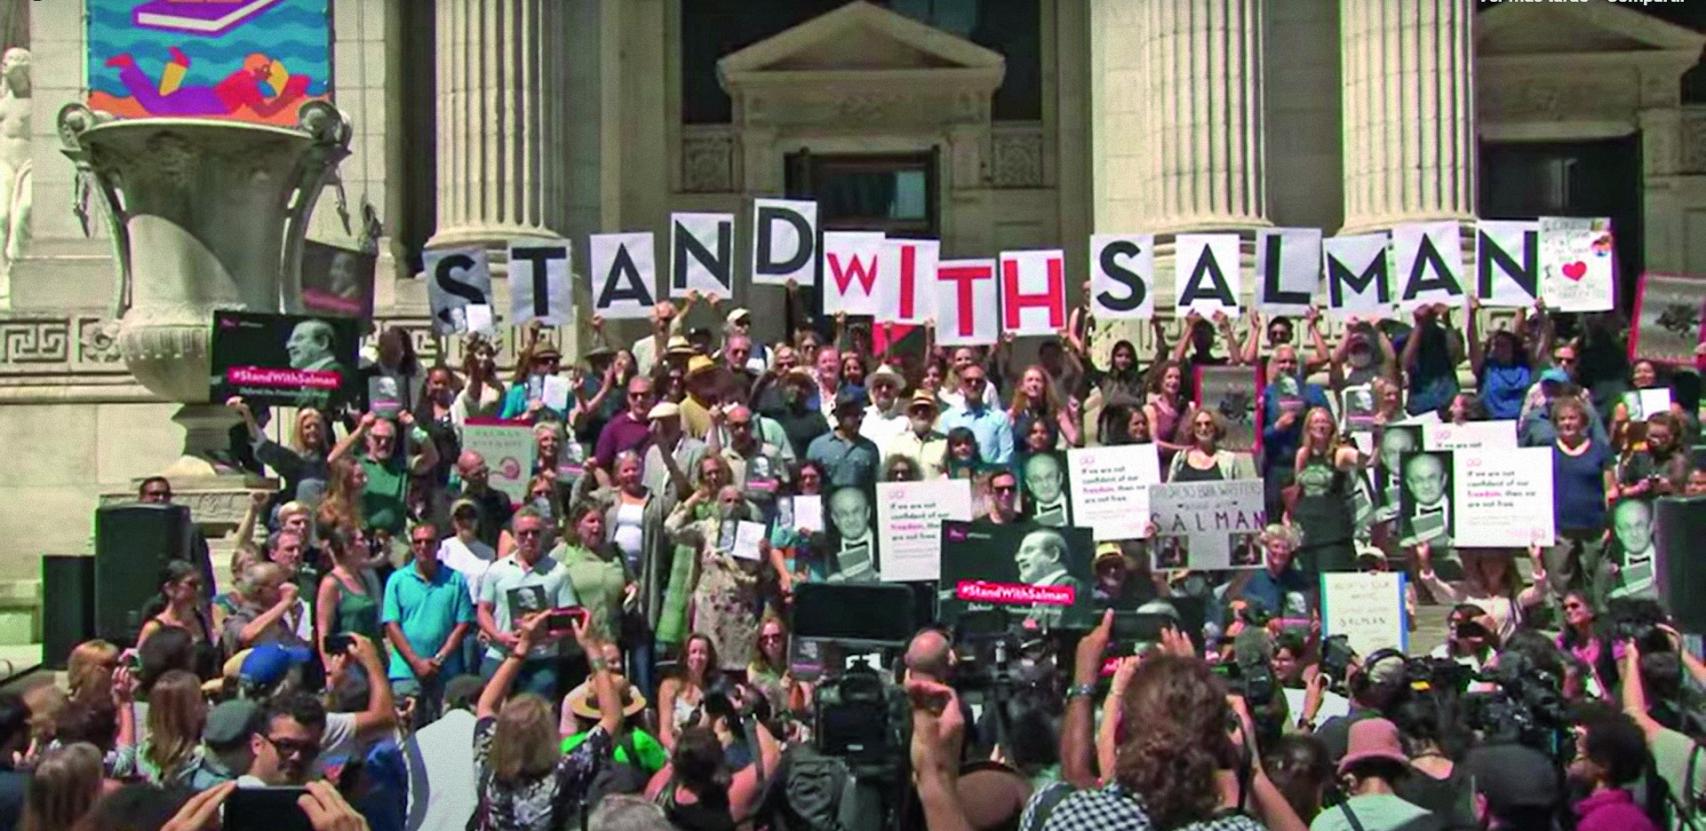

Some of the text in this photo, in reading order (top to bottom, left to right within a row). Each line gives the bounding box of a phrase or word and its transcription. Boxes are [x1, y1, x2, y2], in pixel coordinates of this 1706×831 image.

[826, 245, 1065, 337] WITH
[1096, 230, 1539, 312] SALMAN
[233, 369, 338, 387] #StandWithSalman
[1149, 510, 1268, 532] SALMAN
[961, 584, 1070, 602] #StandWithSalman
